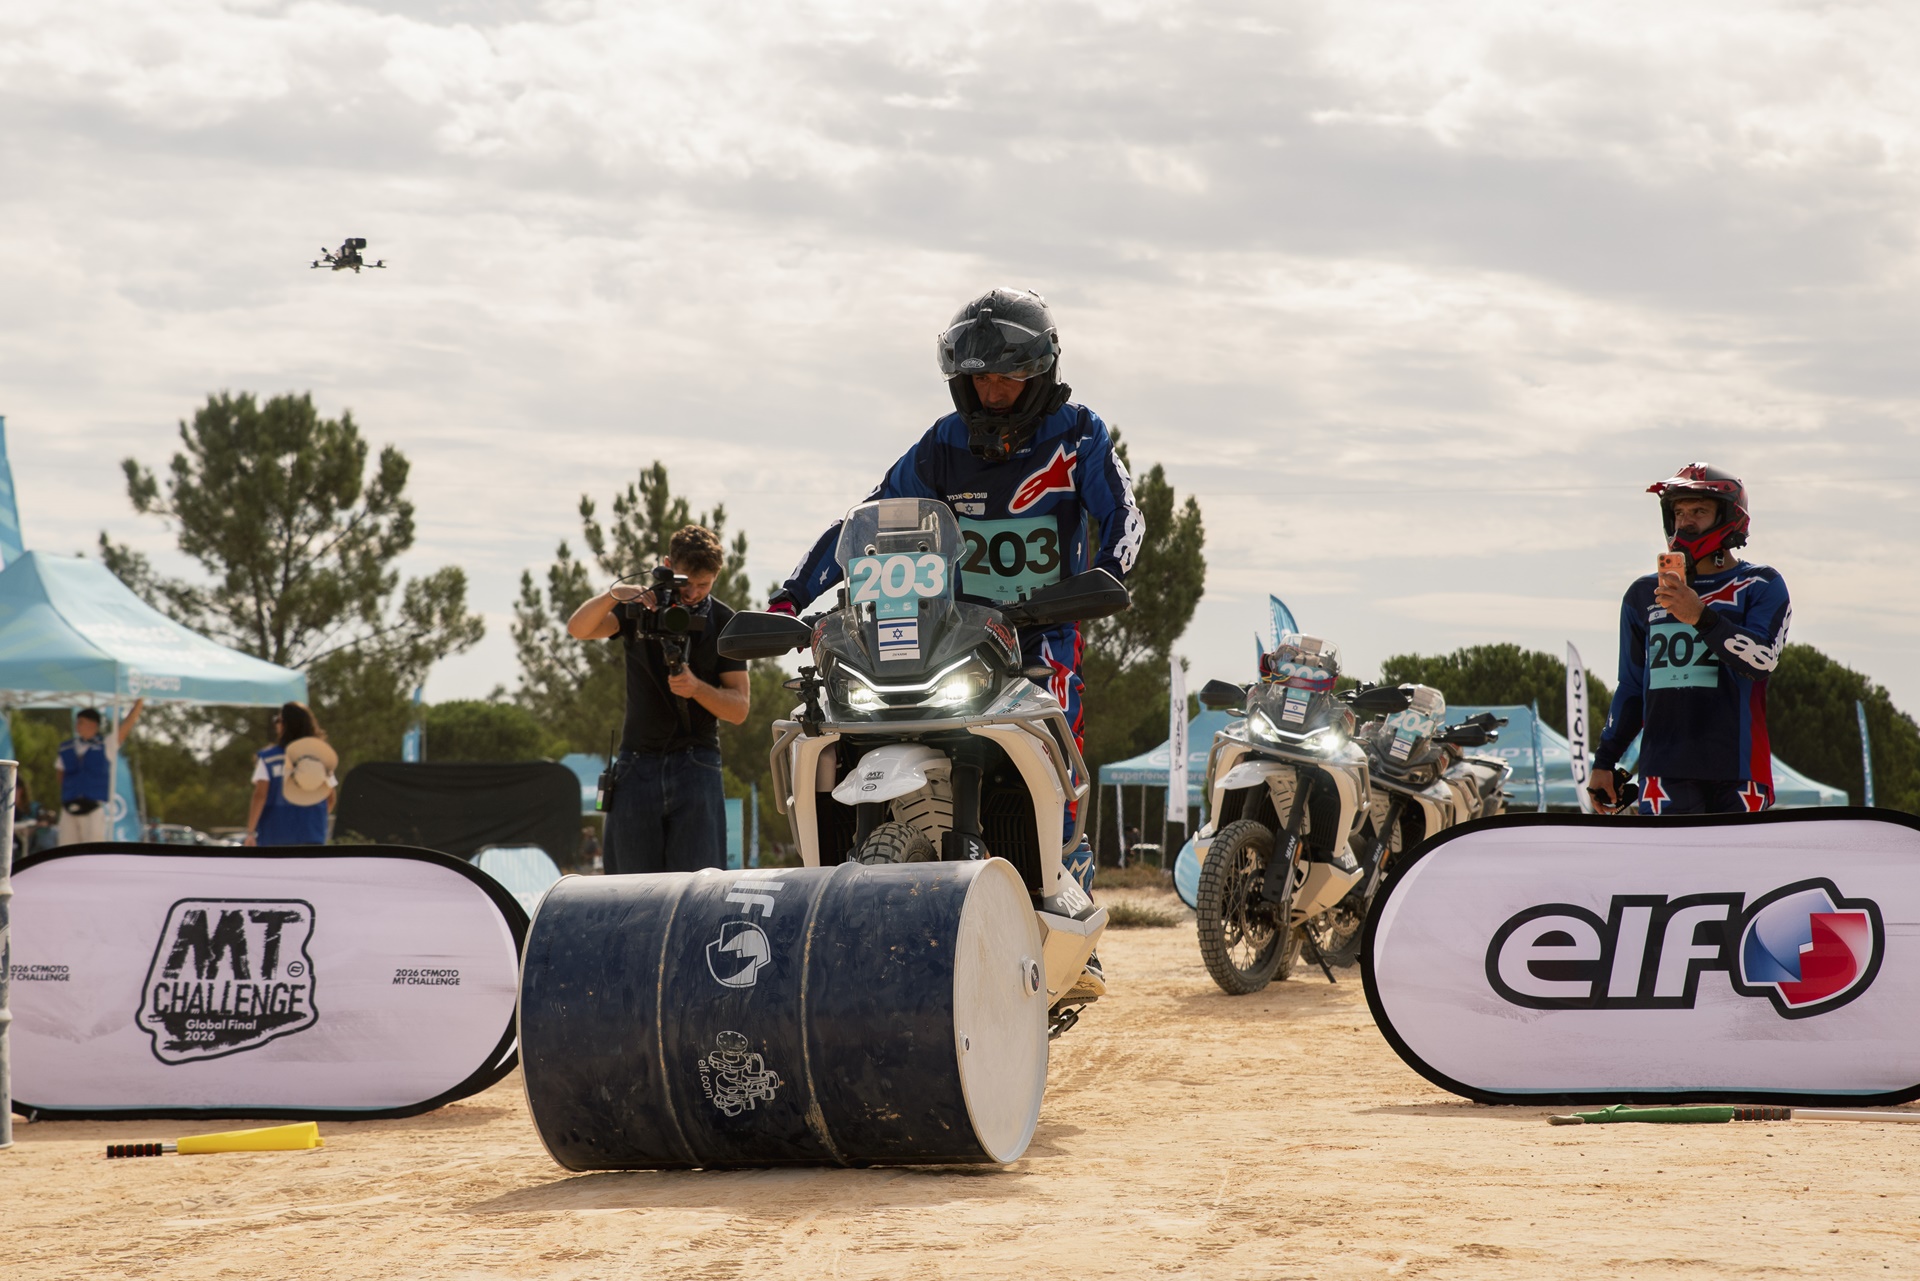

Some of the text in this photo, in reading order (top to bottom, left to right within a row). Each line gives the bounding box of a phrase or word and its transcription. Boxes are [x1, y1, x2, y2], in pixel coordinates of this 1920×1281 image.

[960, 527, 1060, 577] 203
[853, 554, 945, 602] 203
[1650, 631, 1718, 669] 202
[1389, 711, 1435, 738] 204
[725, 878, 785, 918] lf
[1056, 887, 1087, 919] 203
[161, 909, 304, 981] MT
[1492, 899, 1736, 1001] elf
[9, 965, 70, 973] 026 CFMOTO
[16, 973, 71, 982] CHALLENGE
[392, 977, 461, 986] MT CHALLENGE
[395, 968, 460, 978] 2026 CFMOTO
[152, 981, 307, 1016] CHALLENGE
[184, 1030, 216, 1042] 2026
[185, 1018, 258, 1031] Global Final
[697, 1058, 714, 1100] elf.com
